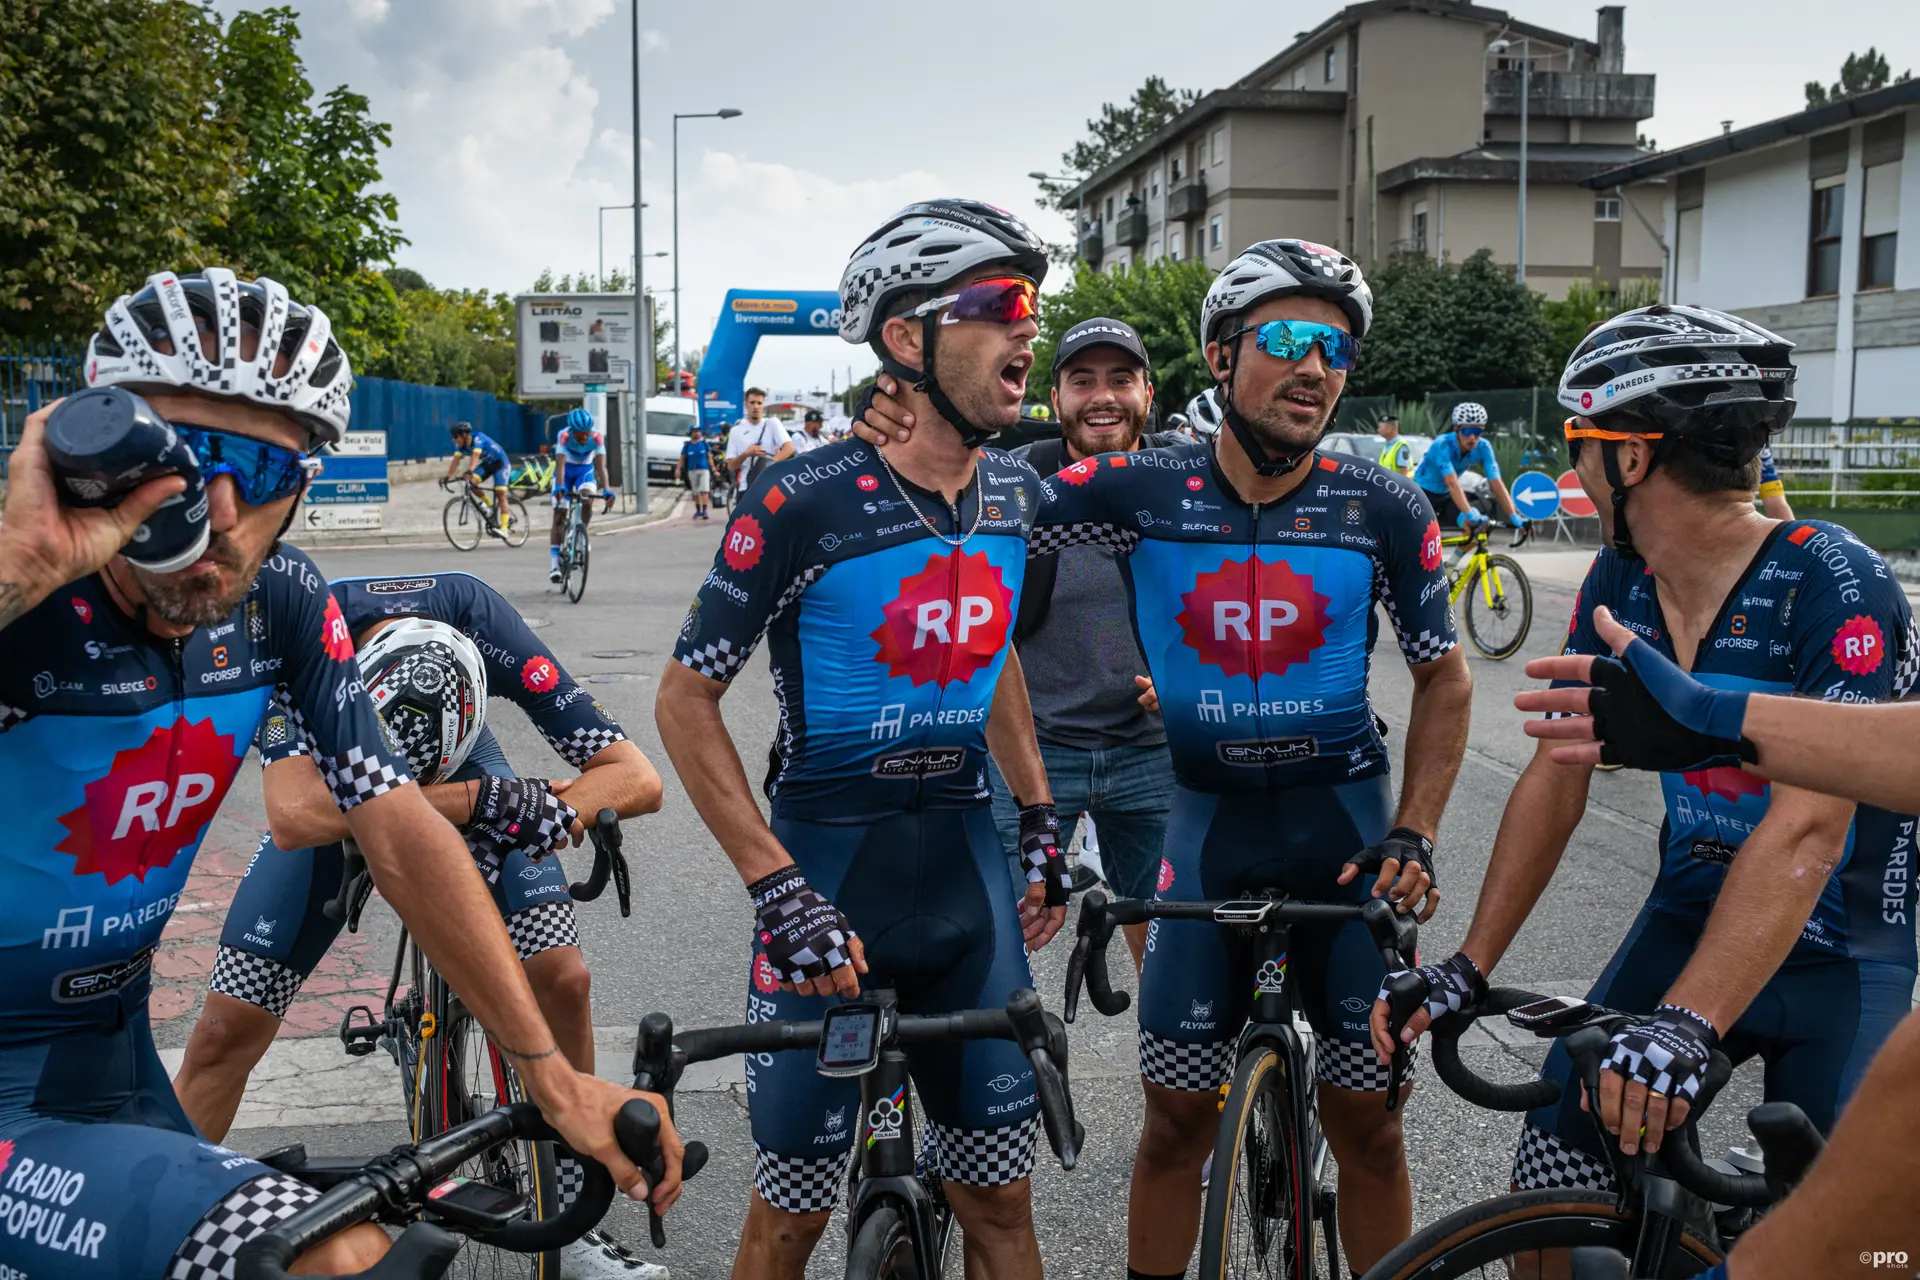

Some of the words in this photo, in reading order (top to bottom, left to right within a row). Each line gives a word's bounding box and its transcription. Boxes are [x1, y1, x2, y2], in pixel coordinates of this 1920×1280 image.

[933, 219, 971, 233] PAREDES
[949, 210, 983, 226] POPULAR
[734, 312, 796, 324] livremente
[1065, 326, 1132, 343] OAKLEY
[1614, 373, 1656, 393] PAREDES
[1769, 370, 1787, 379] NUNES
[1130, 452, 1208, 470] Pelcorte
[782, 449, 868, 495] Pelcorte
[997, 475, 1024, 484] PAREDES
[860, 478, 875, 488] RP
[1189, 479, 1202, 488] RP
[1339, 463, 1423, 520] Pelcorte
[1330, 489, 1369, 497] PAREDES
[977, 518, 1022, 528] OFORSEP
[729, 531, 757, 556] RP
[842, 532, 863, 541] CAM
[1277, 530, 1328, 541] OFORSEP
[1427, 537, 1441, 565] RP
[1805, 531, 1860, 605] Pelcorte
[1750, 596, 1775, 608] FLYNX
[912, 595, 994, 650] RP
[1212, 599, 1300, 642] RP
[1714, 639, 1759, 656] OFORSEP
[1844, 634, 1876, 659] RP
[200, 666, 242, 684] OFORSEP
[530, 663, 563, 692] RP
[60, 682, 85, 692] CAM
[1232, 698, 1325, 718] PAREDES
[909, 706, 986, 730] PAREDES
[1277, 750, 1310, 759] DESIGN
[926, 762, 957, 771] DESIGN
[110, 773, 216, 840] RP
[242, 833, 271, 879] RADIO
[1158, 863, 1168, 887] RP
[1881, 819, 1915, 929] PAREDES
[770, 916, 802, 938] RADIO
[243, 932, 275, 949] FLYNX
[760, 960, 775, 993] RP
[1180, 1020, 1217, 1035] FLYNX
[1659, 1029, 1705, 1060] POPULAR
[813, 1129, 849, 1145] FLYNX
[4, 1157, 86, 1208] RADIO
[0, 1193, 108, 1260] POPULAR
